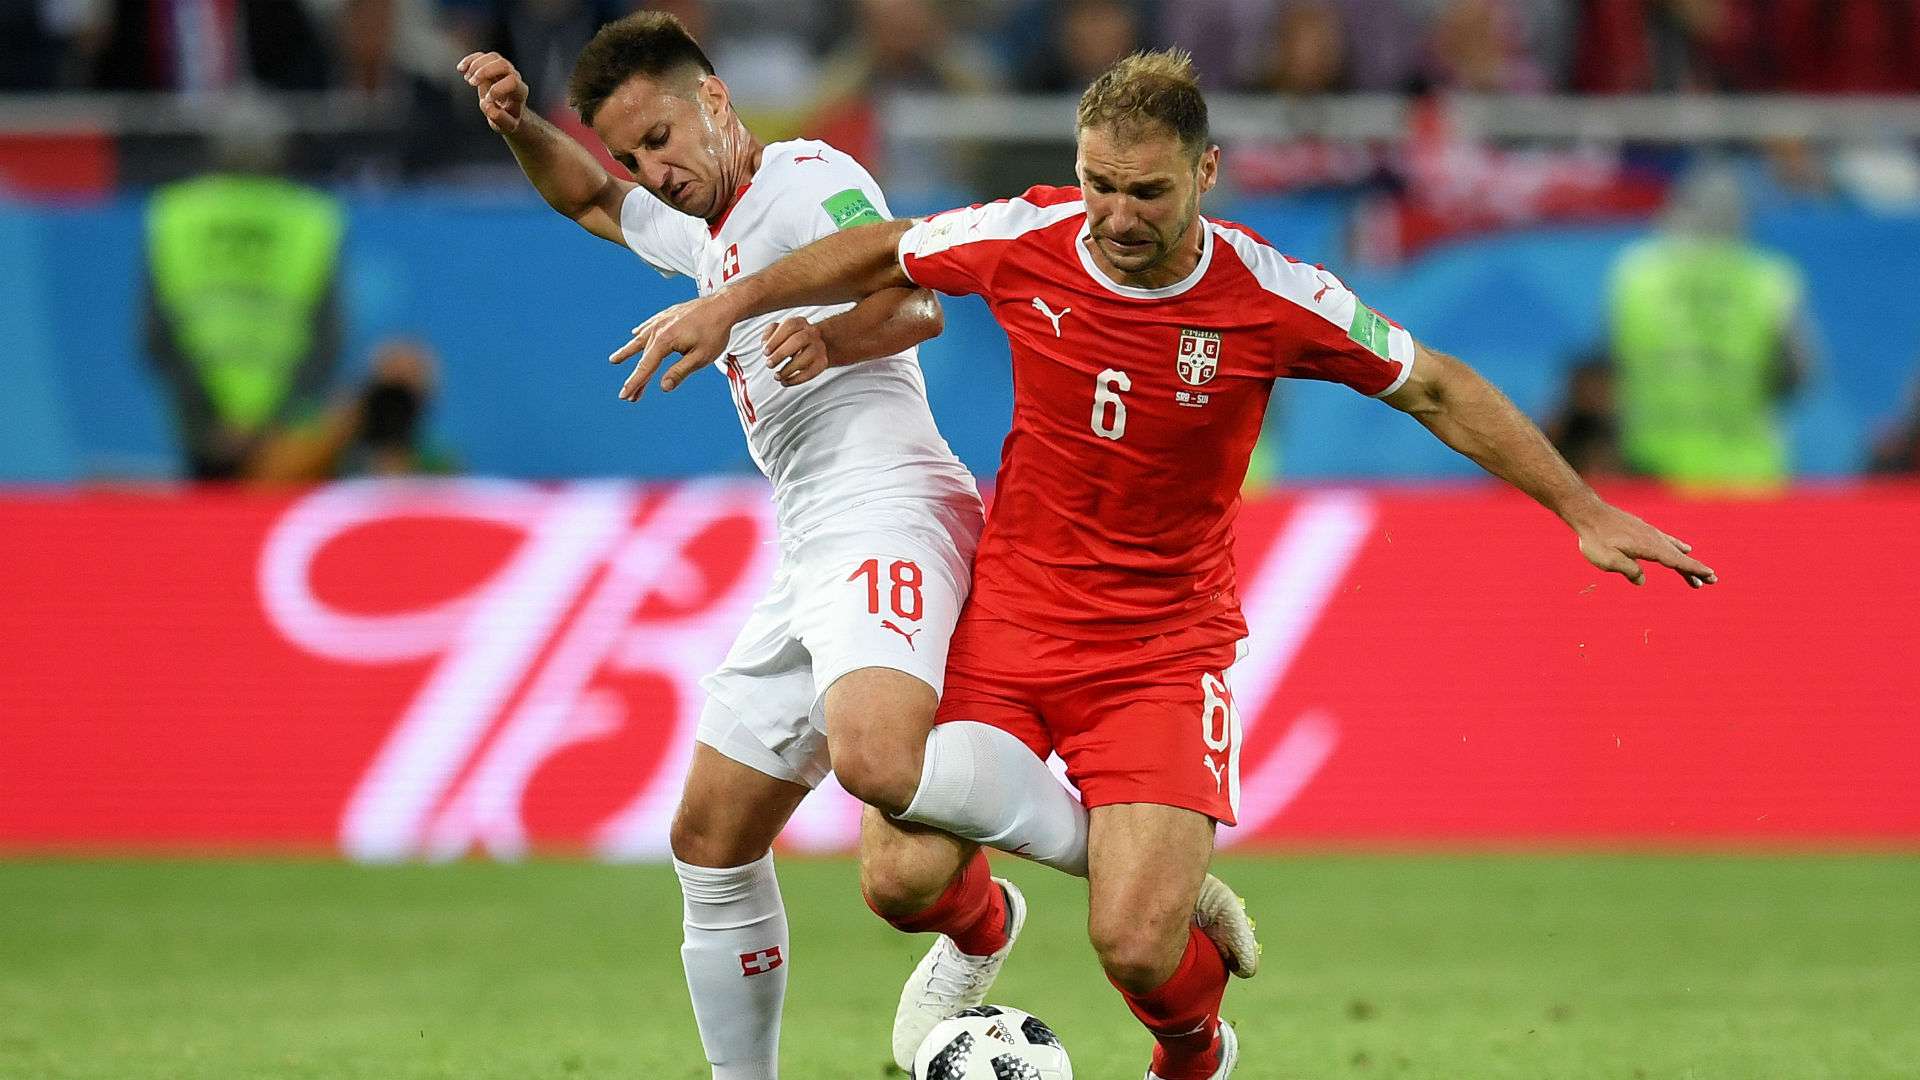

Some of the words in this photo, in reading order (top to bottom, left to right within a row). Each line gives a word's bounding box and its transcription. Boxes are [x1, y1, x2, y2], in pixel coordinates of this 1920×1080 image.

[1090, 368, 1132, 441] 6
[846, 559, 923, 622] 18
[1201, 672, 1230, 752] 6
